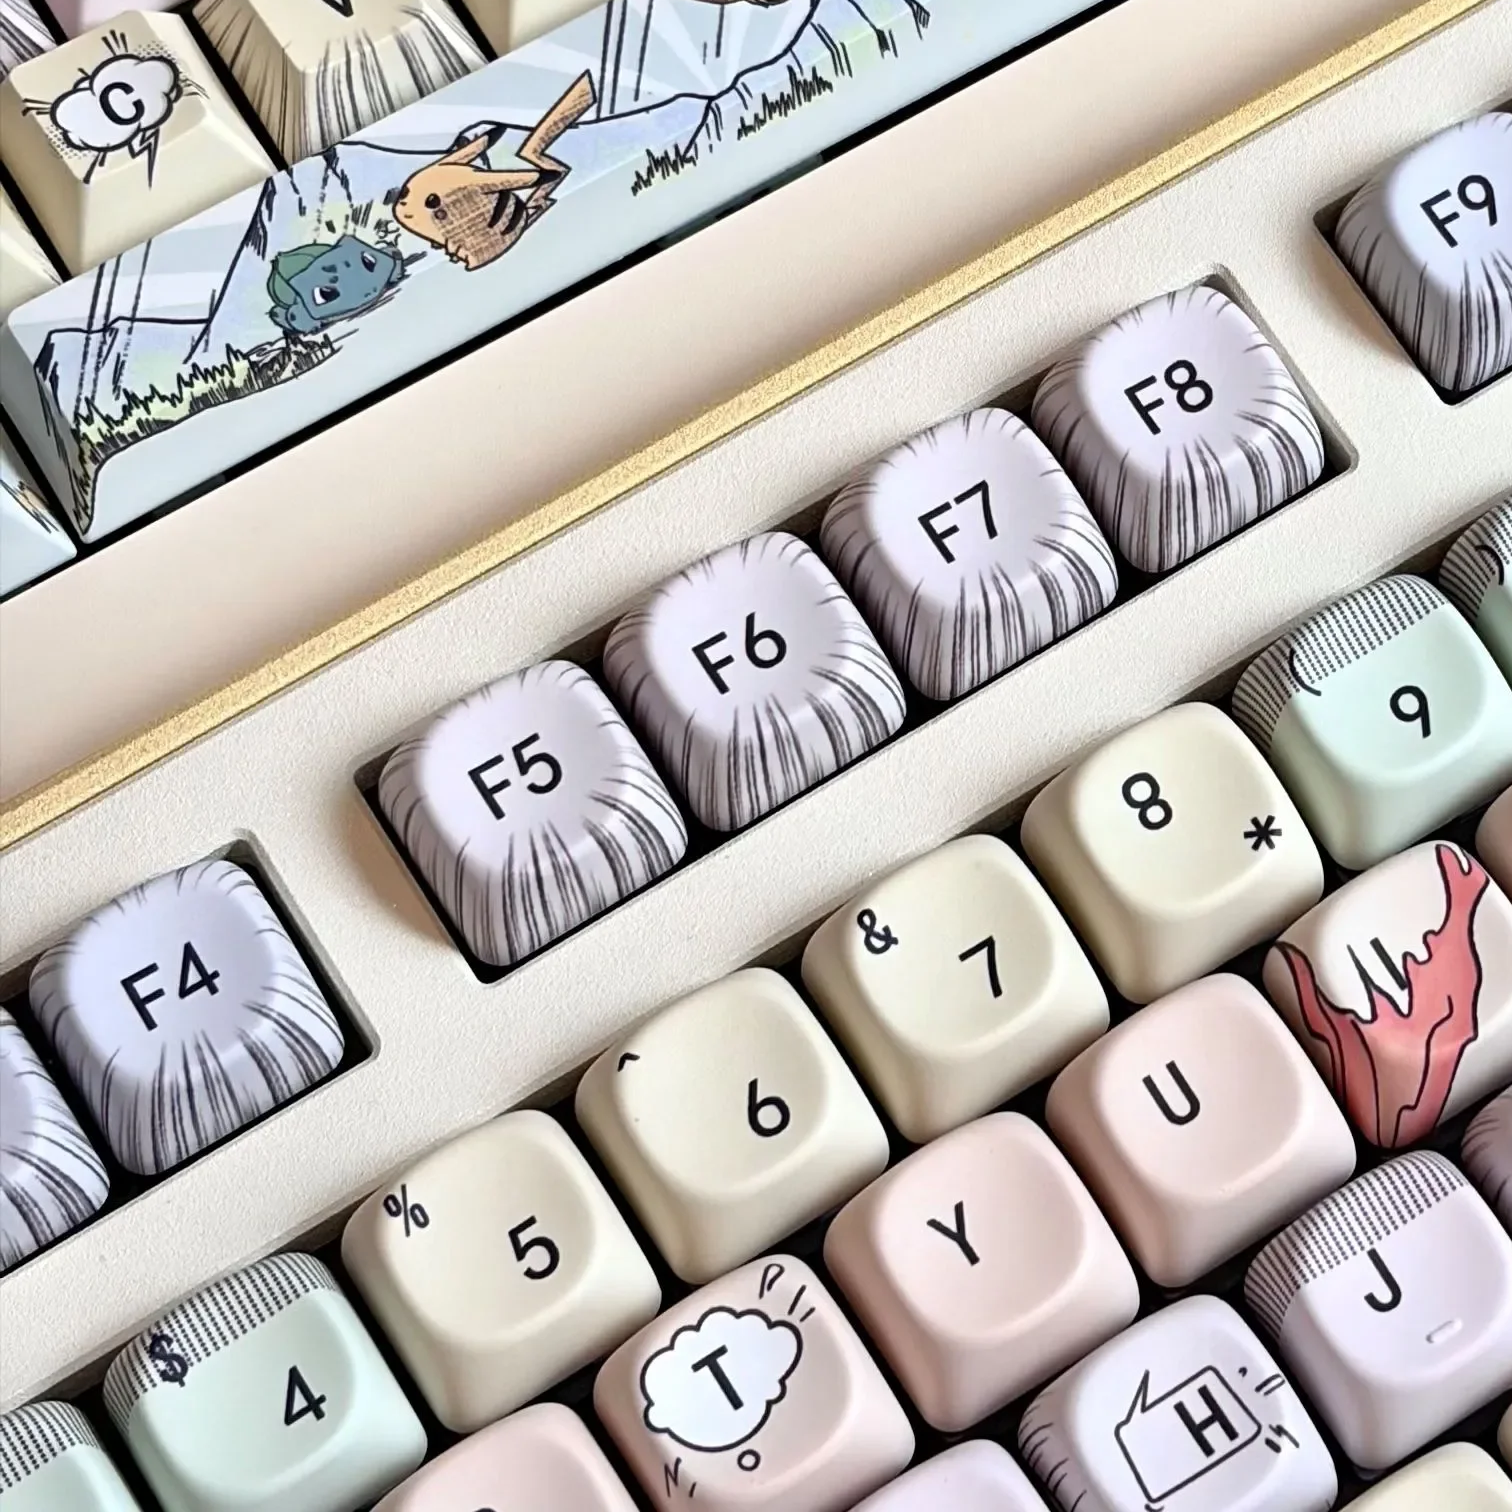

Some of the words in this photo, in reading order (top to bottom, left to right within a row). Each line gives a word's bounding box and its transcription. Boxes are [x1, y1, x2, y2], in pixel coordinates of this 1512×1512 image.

[99, 81, 145, 126] C
[1420, 174, 1498, 248] F9
[1124, 359, 1213, 435] F8
[917, 479, 998, 564] F7
[691, 612, 787, 695] F6
[1389, 685, 1431, 739] 9
[467, 732, 563, 820] F5
[1121, 772, 1173, 831] 8
[120, 941, 220, 1031] F4
[958, 935, 1003, 999] 7
[747, 1078, 791, 1138] 6
[1142, 1060, 1201, 1126] U
[382, 1183, 430, 1237] %
[508, 1215, 560, 1280] 5
[926, 1201, 980, 1266] Y
[1364, 1248, 1402, 1313] J
[283, 1365, 327, 1427] 4
[691, 1345, 744, 1411] T
[1173, 1384, 1239, 1458] H
